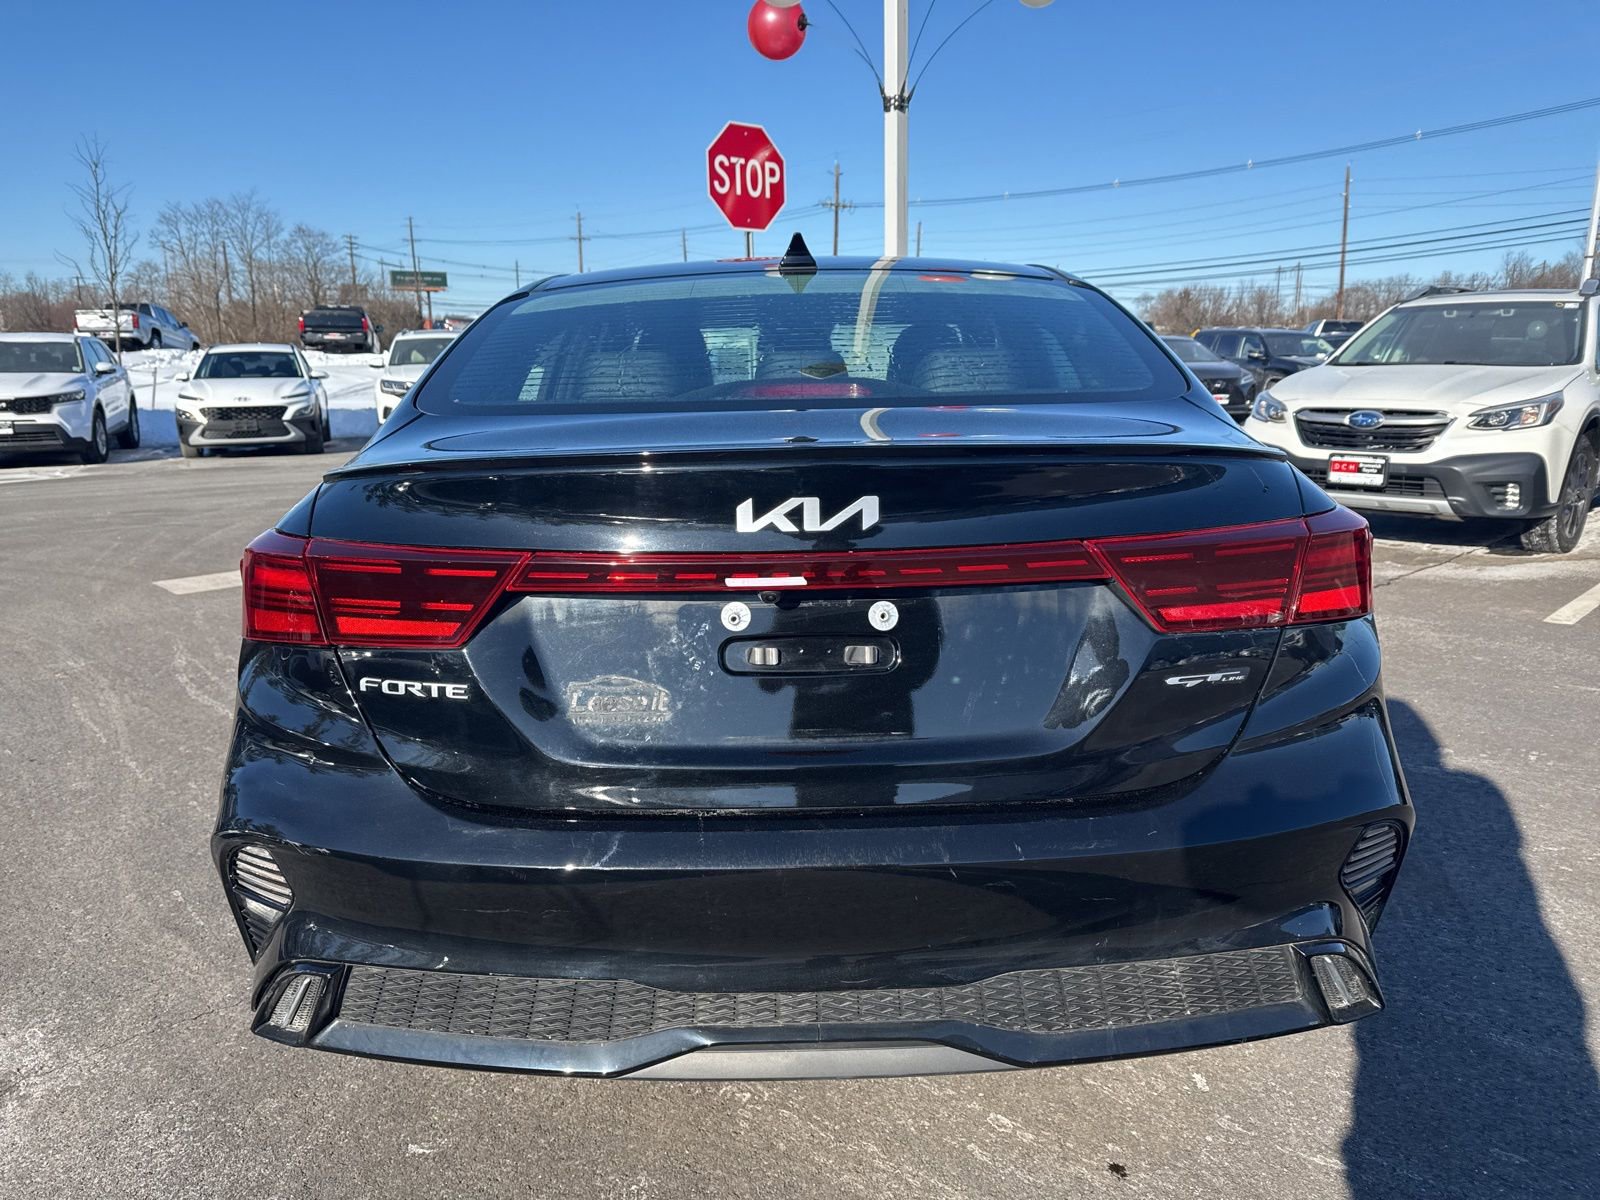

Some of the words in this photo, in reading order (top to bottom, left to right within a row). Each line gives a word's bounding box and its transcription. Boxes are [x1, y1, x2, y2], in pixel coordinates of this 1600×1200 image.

[713, 154, 781, 199] STOP
[736, 495, 880, 533] KIA
[359, 677, 468, 699] FORTE
